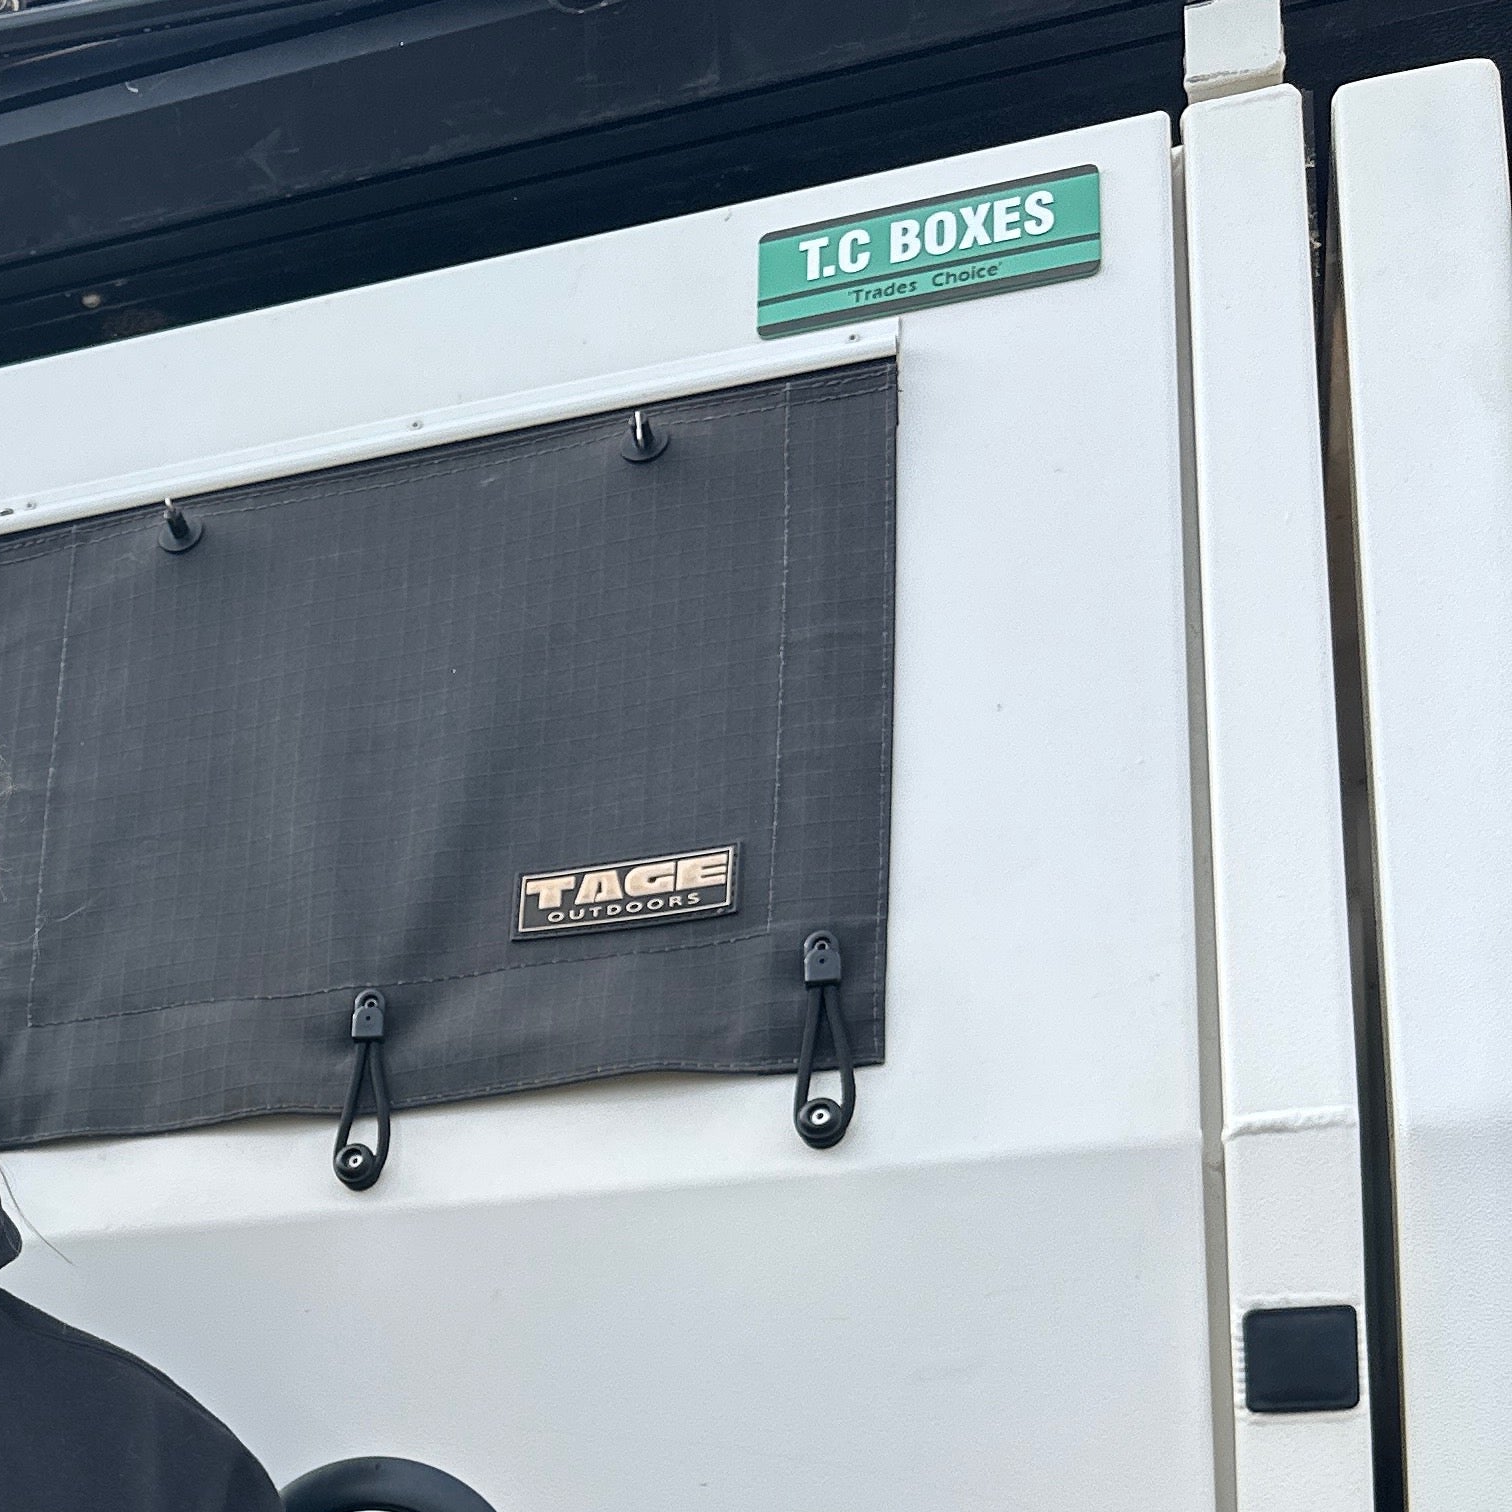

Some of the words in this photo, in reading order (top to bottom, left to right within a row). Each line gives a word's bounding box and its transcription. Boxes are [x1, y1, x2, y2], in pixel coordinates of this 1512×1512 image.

[799, 229, 872, 281] T.C
[889, 190, 1055, 265] BOXES
[525, 853, 729, 910] TAGE
[547, 892, 701, 923] OUTDOORS
